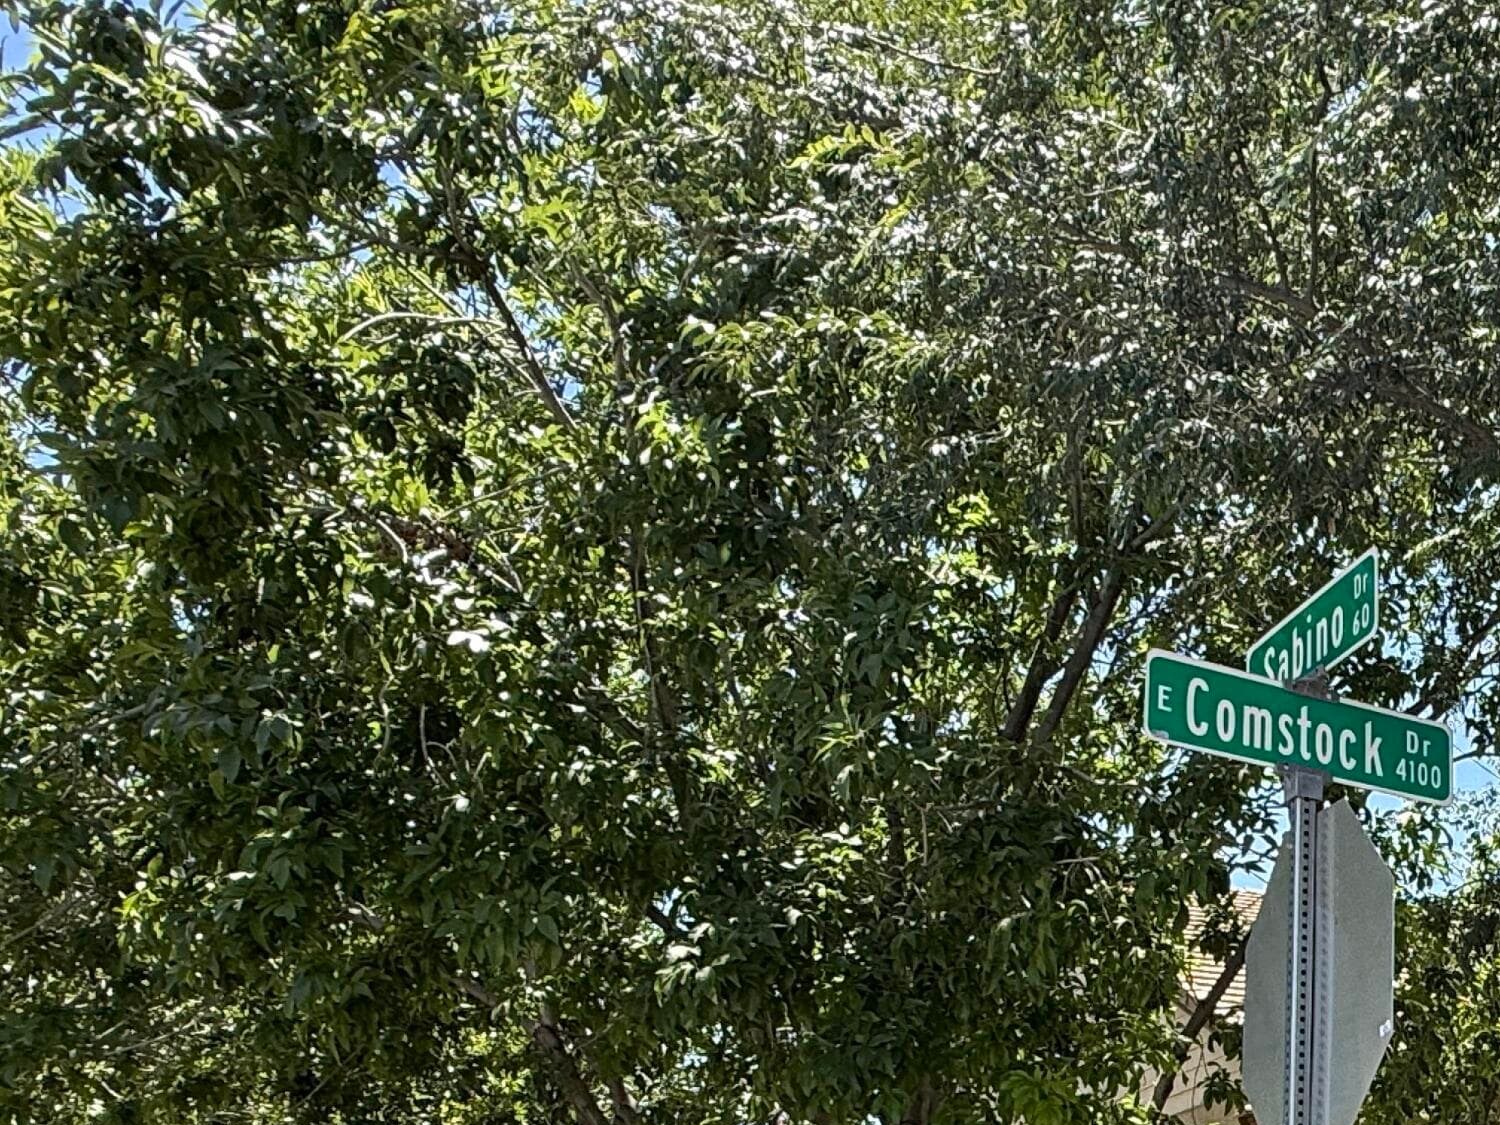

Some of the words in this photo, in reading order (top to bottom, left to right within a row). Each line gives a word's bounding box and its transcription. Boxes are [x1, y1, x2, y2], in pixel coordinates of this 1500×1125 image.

[1264, 605, 1344, 682] Sabino
[1354, 573, 1368, 599] Dr
[1352, 603, 1370, 636] 60
[1157, 684, 1173, 712] E
[1186, 677, 1384, 777] Comstock
[1406, 730, 1432, 757] Dr
[1395, 757, 1442, 789] 4100
